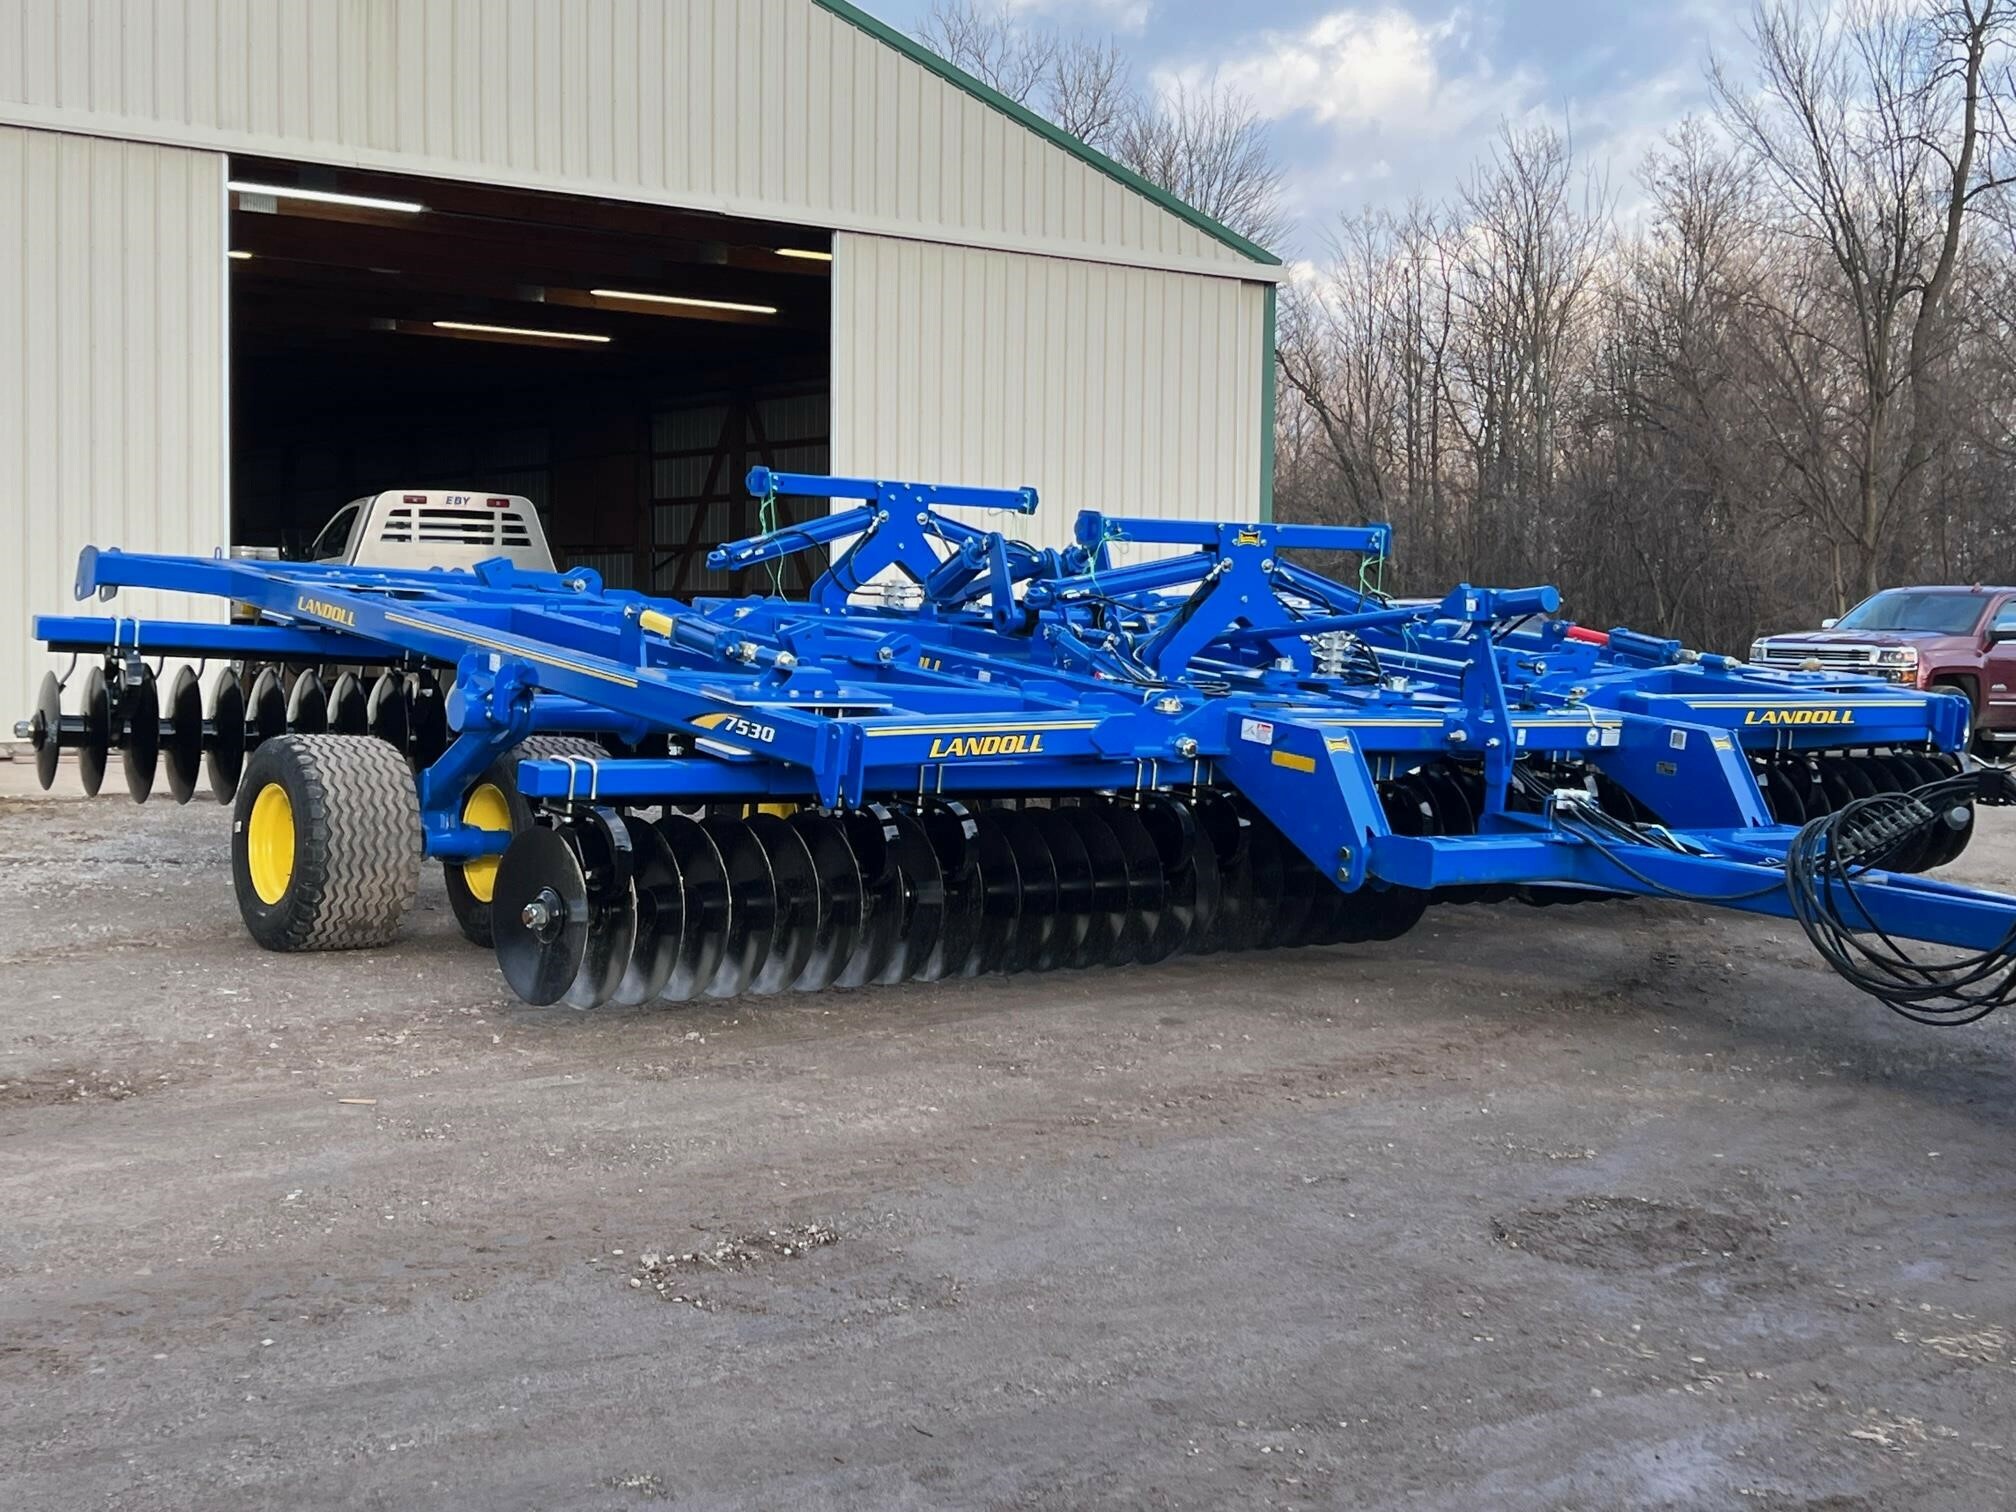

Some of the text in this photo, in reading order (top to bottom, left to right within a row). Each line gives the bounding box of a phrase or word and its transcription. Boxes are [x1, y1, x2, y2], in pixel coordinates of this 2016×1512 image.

[446, 495, 471, 505] EBY
[297, 596, 356, 627] LANDOLL
[724, 715, 776, 743] 7530
[1744, 710, 1855, 725] LANDOLL
[929, 734, 1044, 758] LANDOLL
